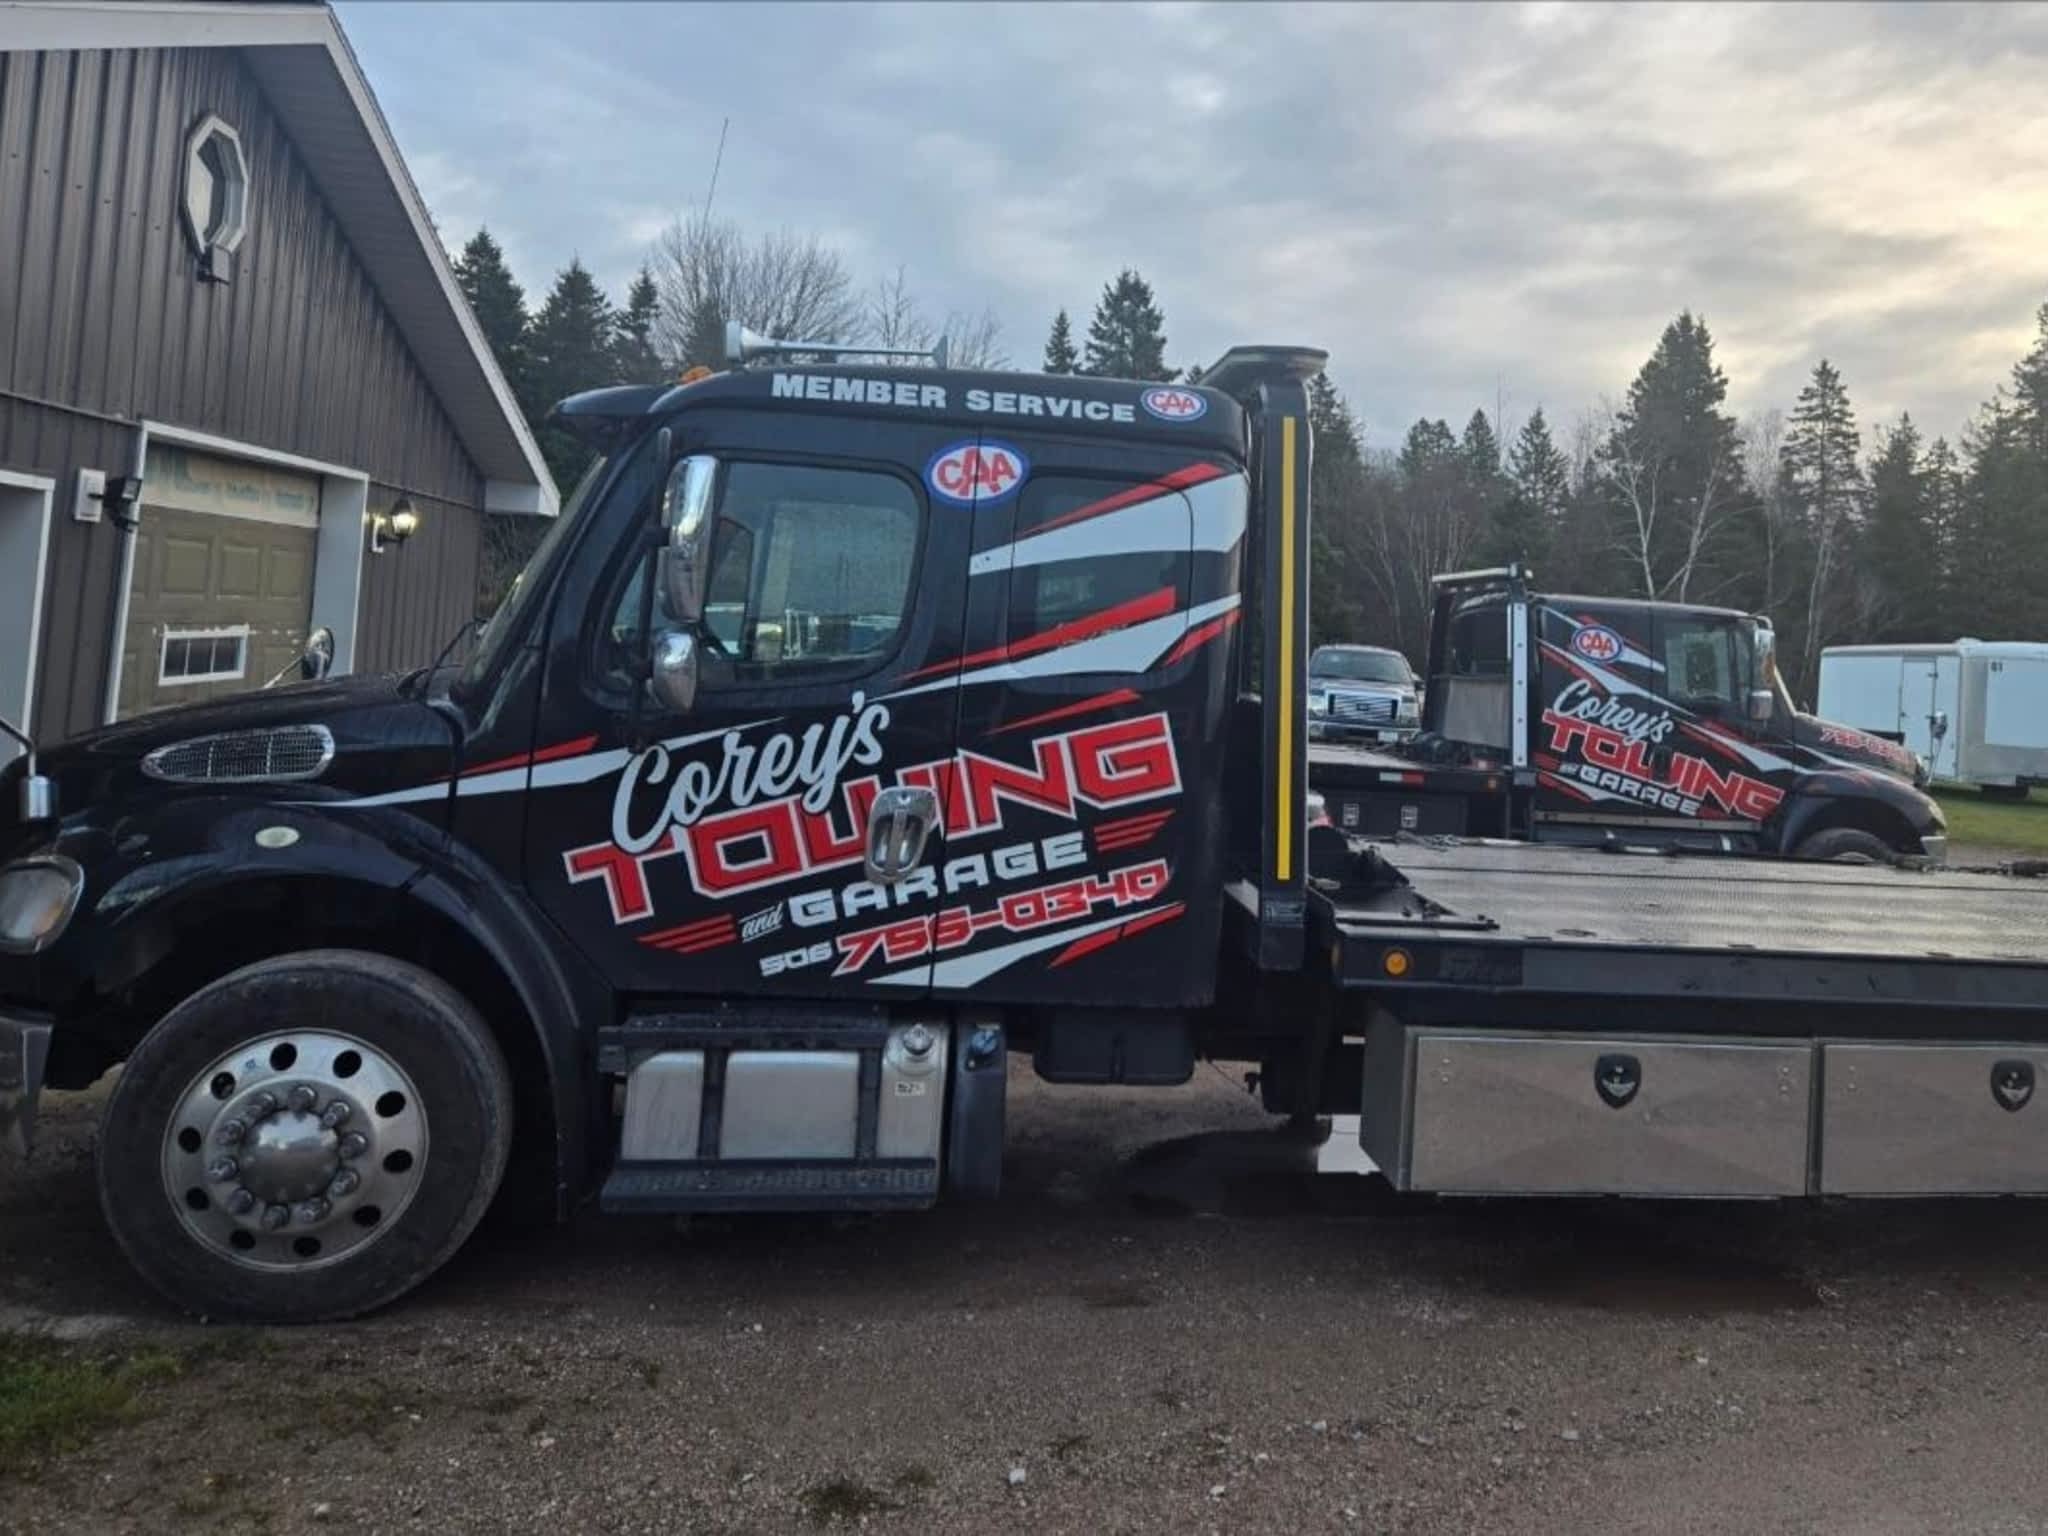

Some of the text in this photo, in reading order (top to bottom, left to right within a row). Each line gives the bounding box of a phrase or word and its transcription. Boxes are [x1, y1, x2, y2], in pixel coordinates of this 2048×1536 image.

[771, 373, 1136, 423] MEMBER SERVICE
[1150, 391, 1197, 414] CAA
[936, 446, 1017, 498] CAA
[1578, 631, 1614, 657] CAA
[1553, 678, 1674, 746] Corey's
[611, 690, 890, 854] Corey's
[1541, 708, 1786, 821] TOWING
[1579, 764, 1701, 817] GARAGE
[562, 711, 1183, 926] TOWING
[738, 831, 1088, 944] and GARAGE
[759, 857, 1170, 977] 506 755-0340
